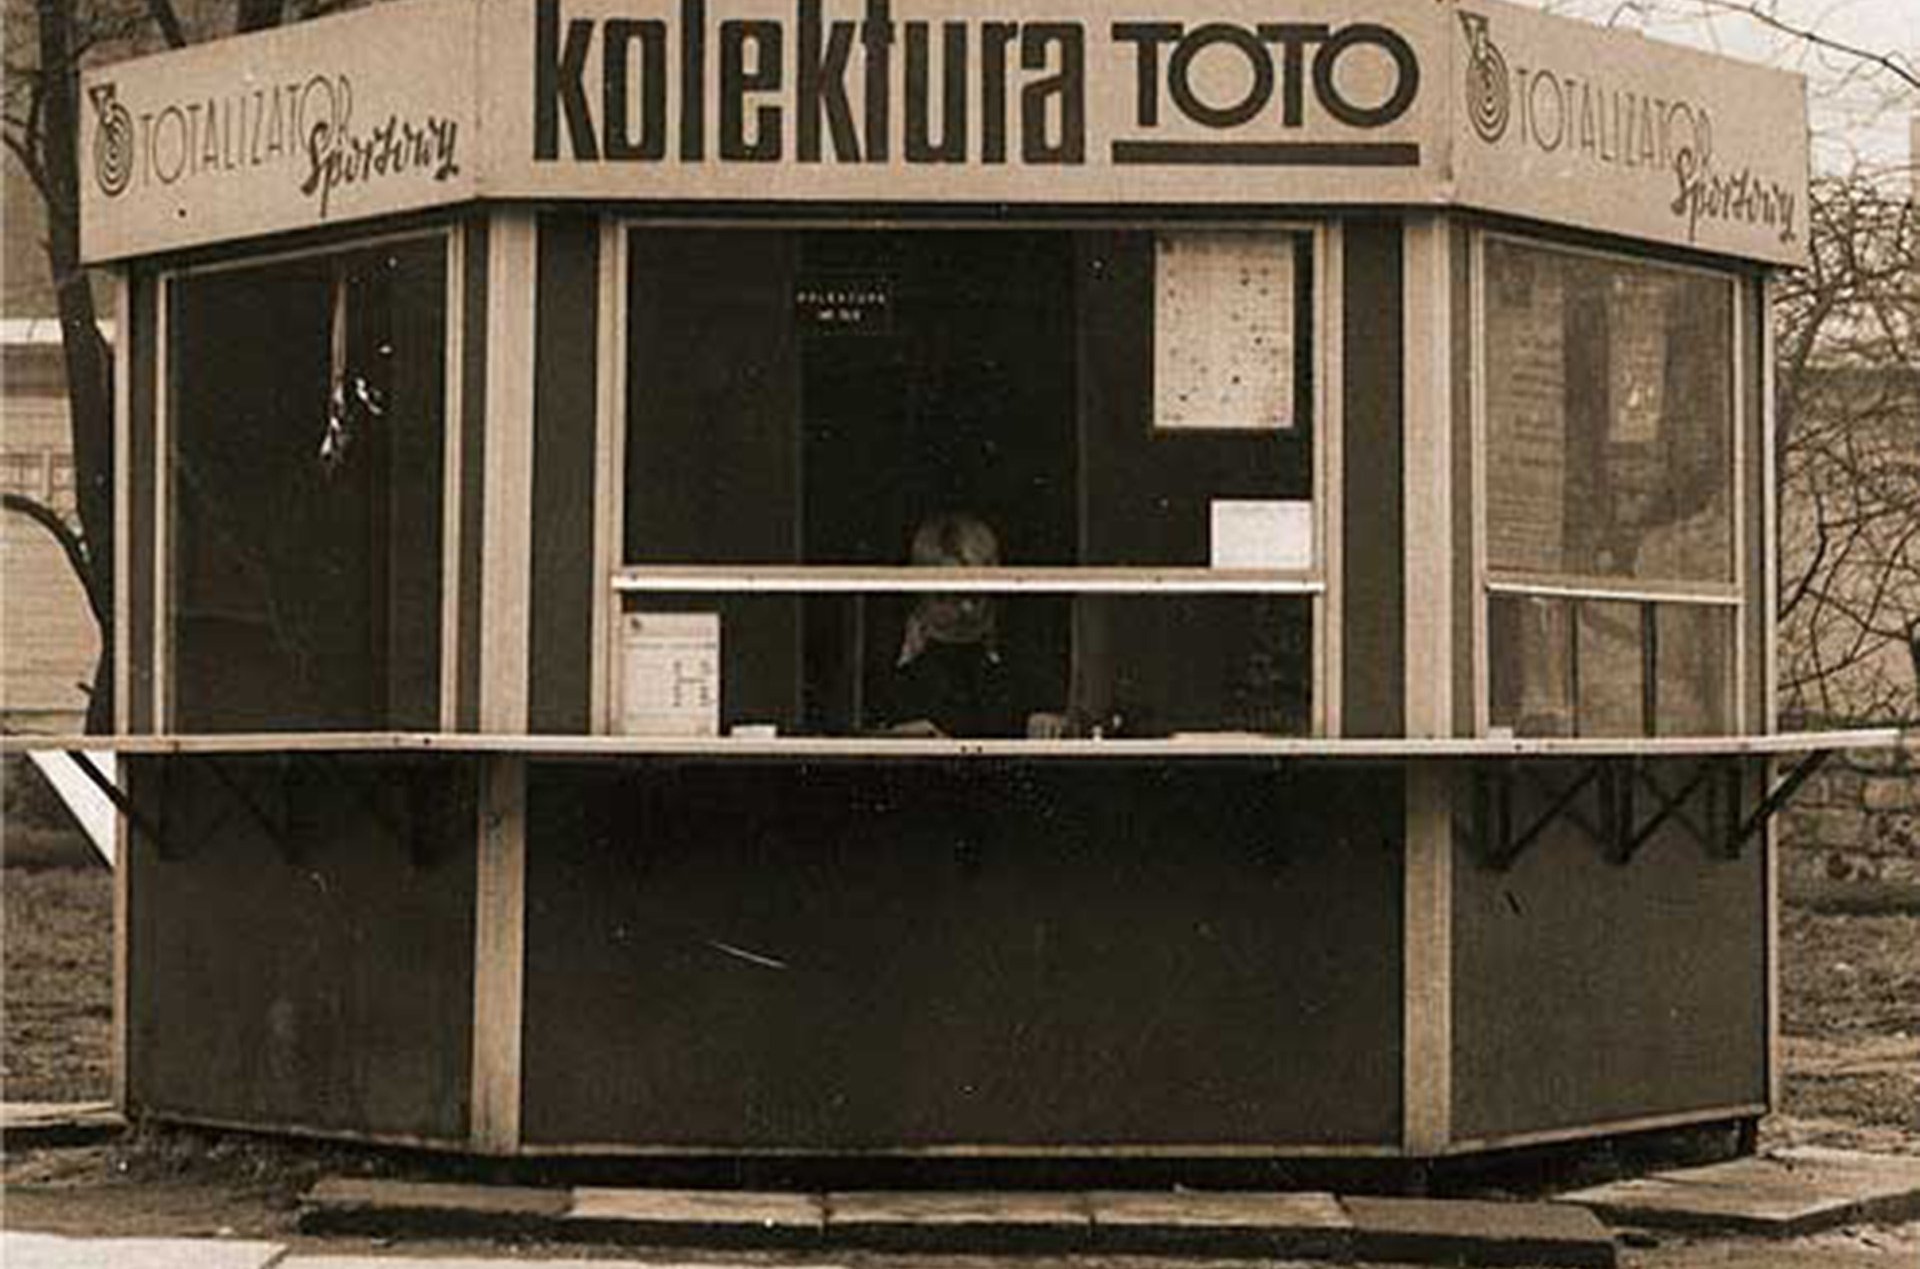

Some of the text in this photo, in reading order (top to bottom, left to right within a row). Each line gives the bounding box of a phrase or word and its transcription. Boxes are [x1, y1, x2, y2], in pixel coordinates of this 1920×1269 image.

[138, 74, 353, 187] TOTALIZATOR
[533, 0, 1421, 163] kolektura TOTO
[1516, 68, 1713, 176] TOTALIZATOR
[301, 114, 460, 218] Sportowy
